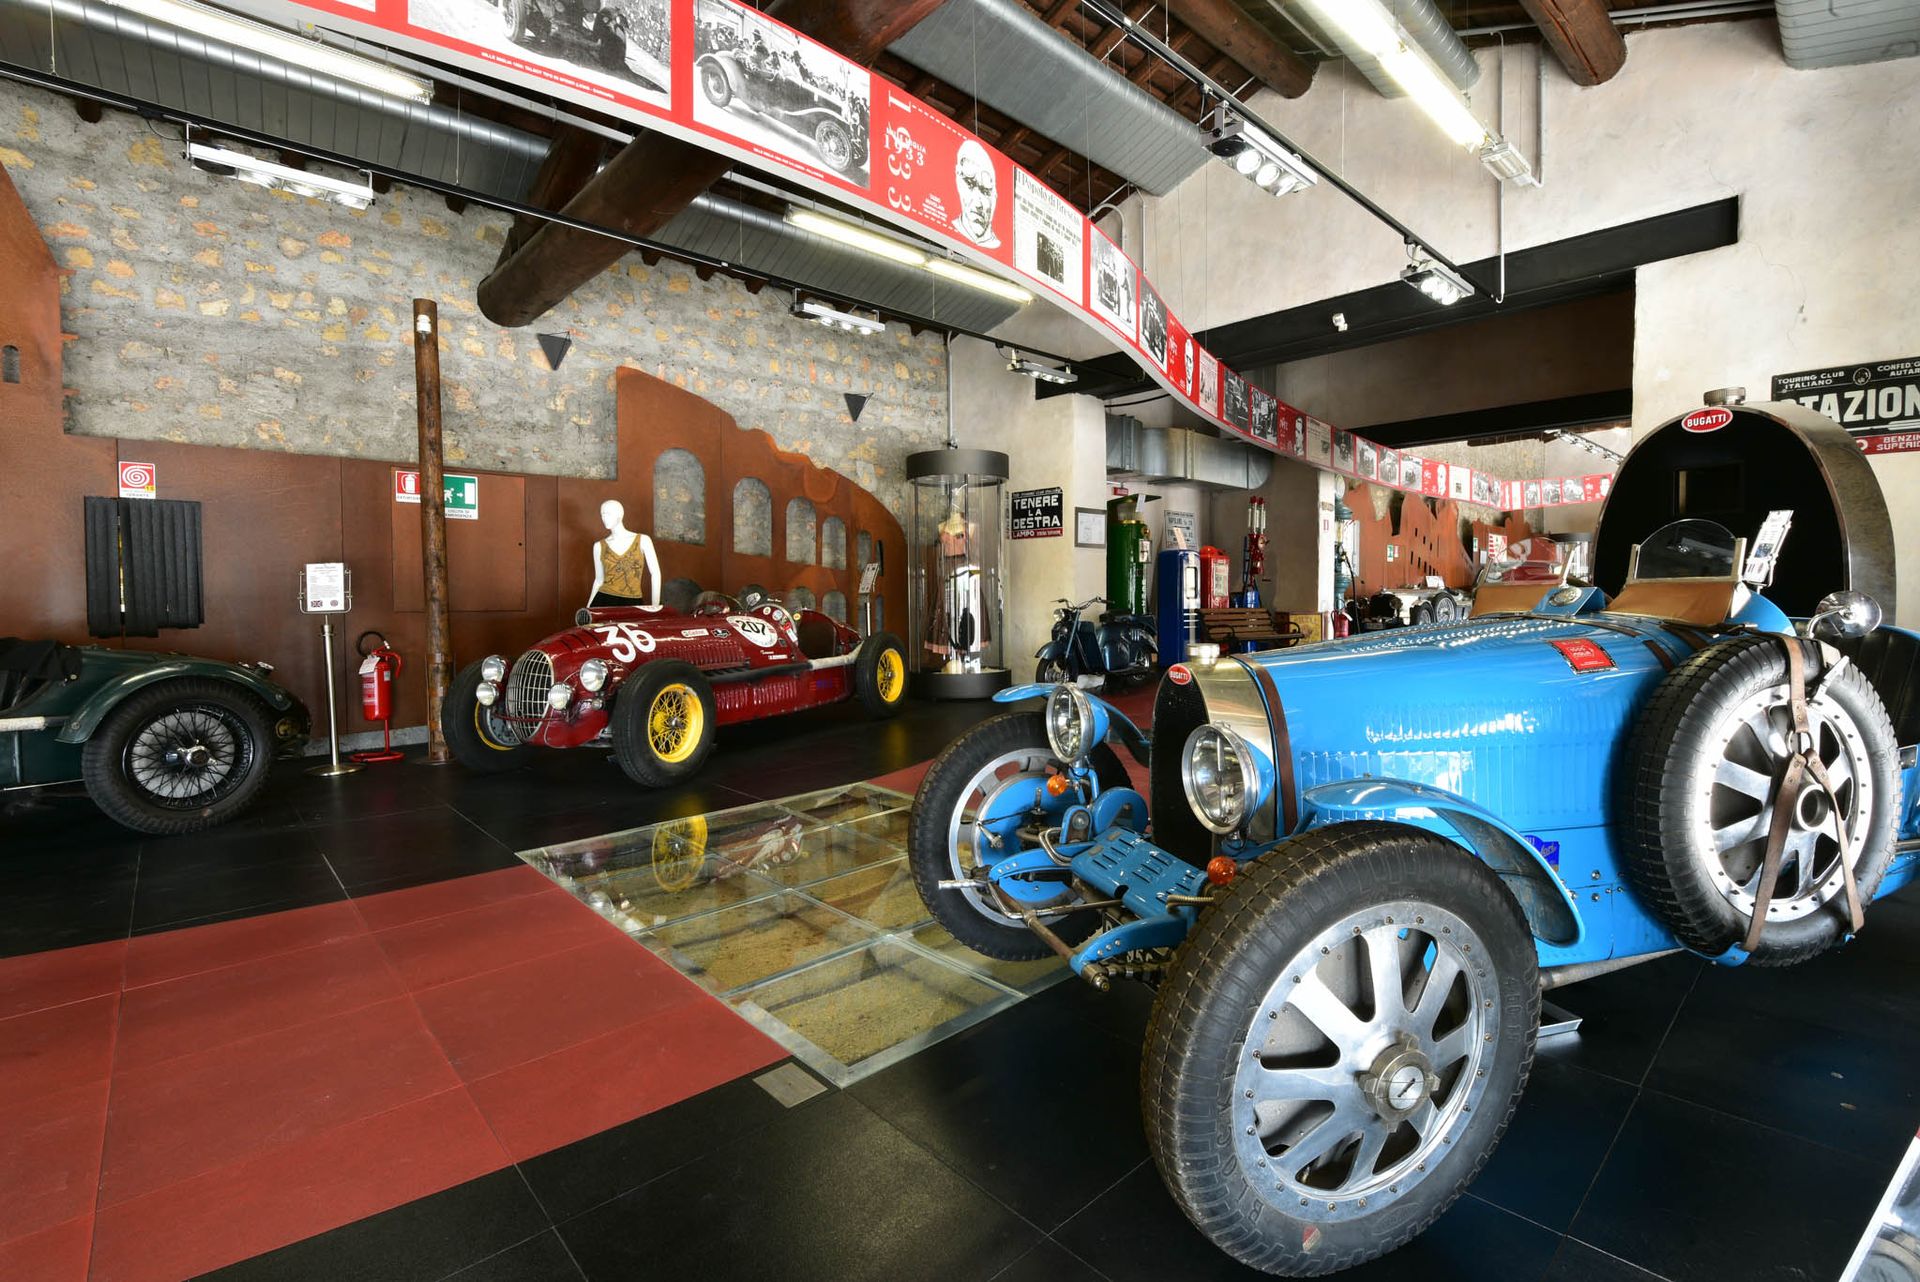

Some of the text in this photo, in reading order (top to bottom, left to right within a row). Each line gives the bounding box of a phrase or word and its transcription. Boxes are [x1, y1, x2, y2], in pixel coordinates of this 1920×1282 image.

[1778, 371, 1845, 385] TOURING CLUB
[1785, 379, 1833, 390] ITALIANO
[1687, 413, 1727, 428] BUGATTI
[1014, 494, 1059, 510] TENERE
[1028, 508, 1042, 517] LA
[1013, 515, 1061, 530] DESTRA
[1013, 530, 1035, 538] LAMPO
[735, 620, 766, 636] 207
[594, 622, 657, 663] 36
[1170, 670, 1188, 680] BUGATTI
